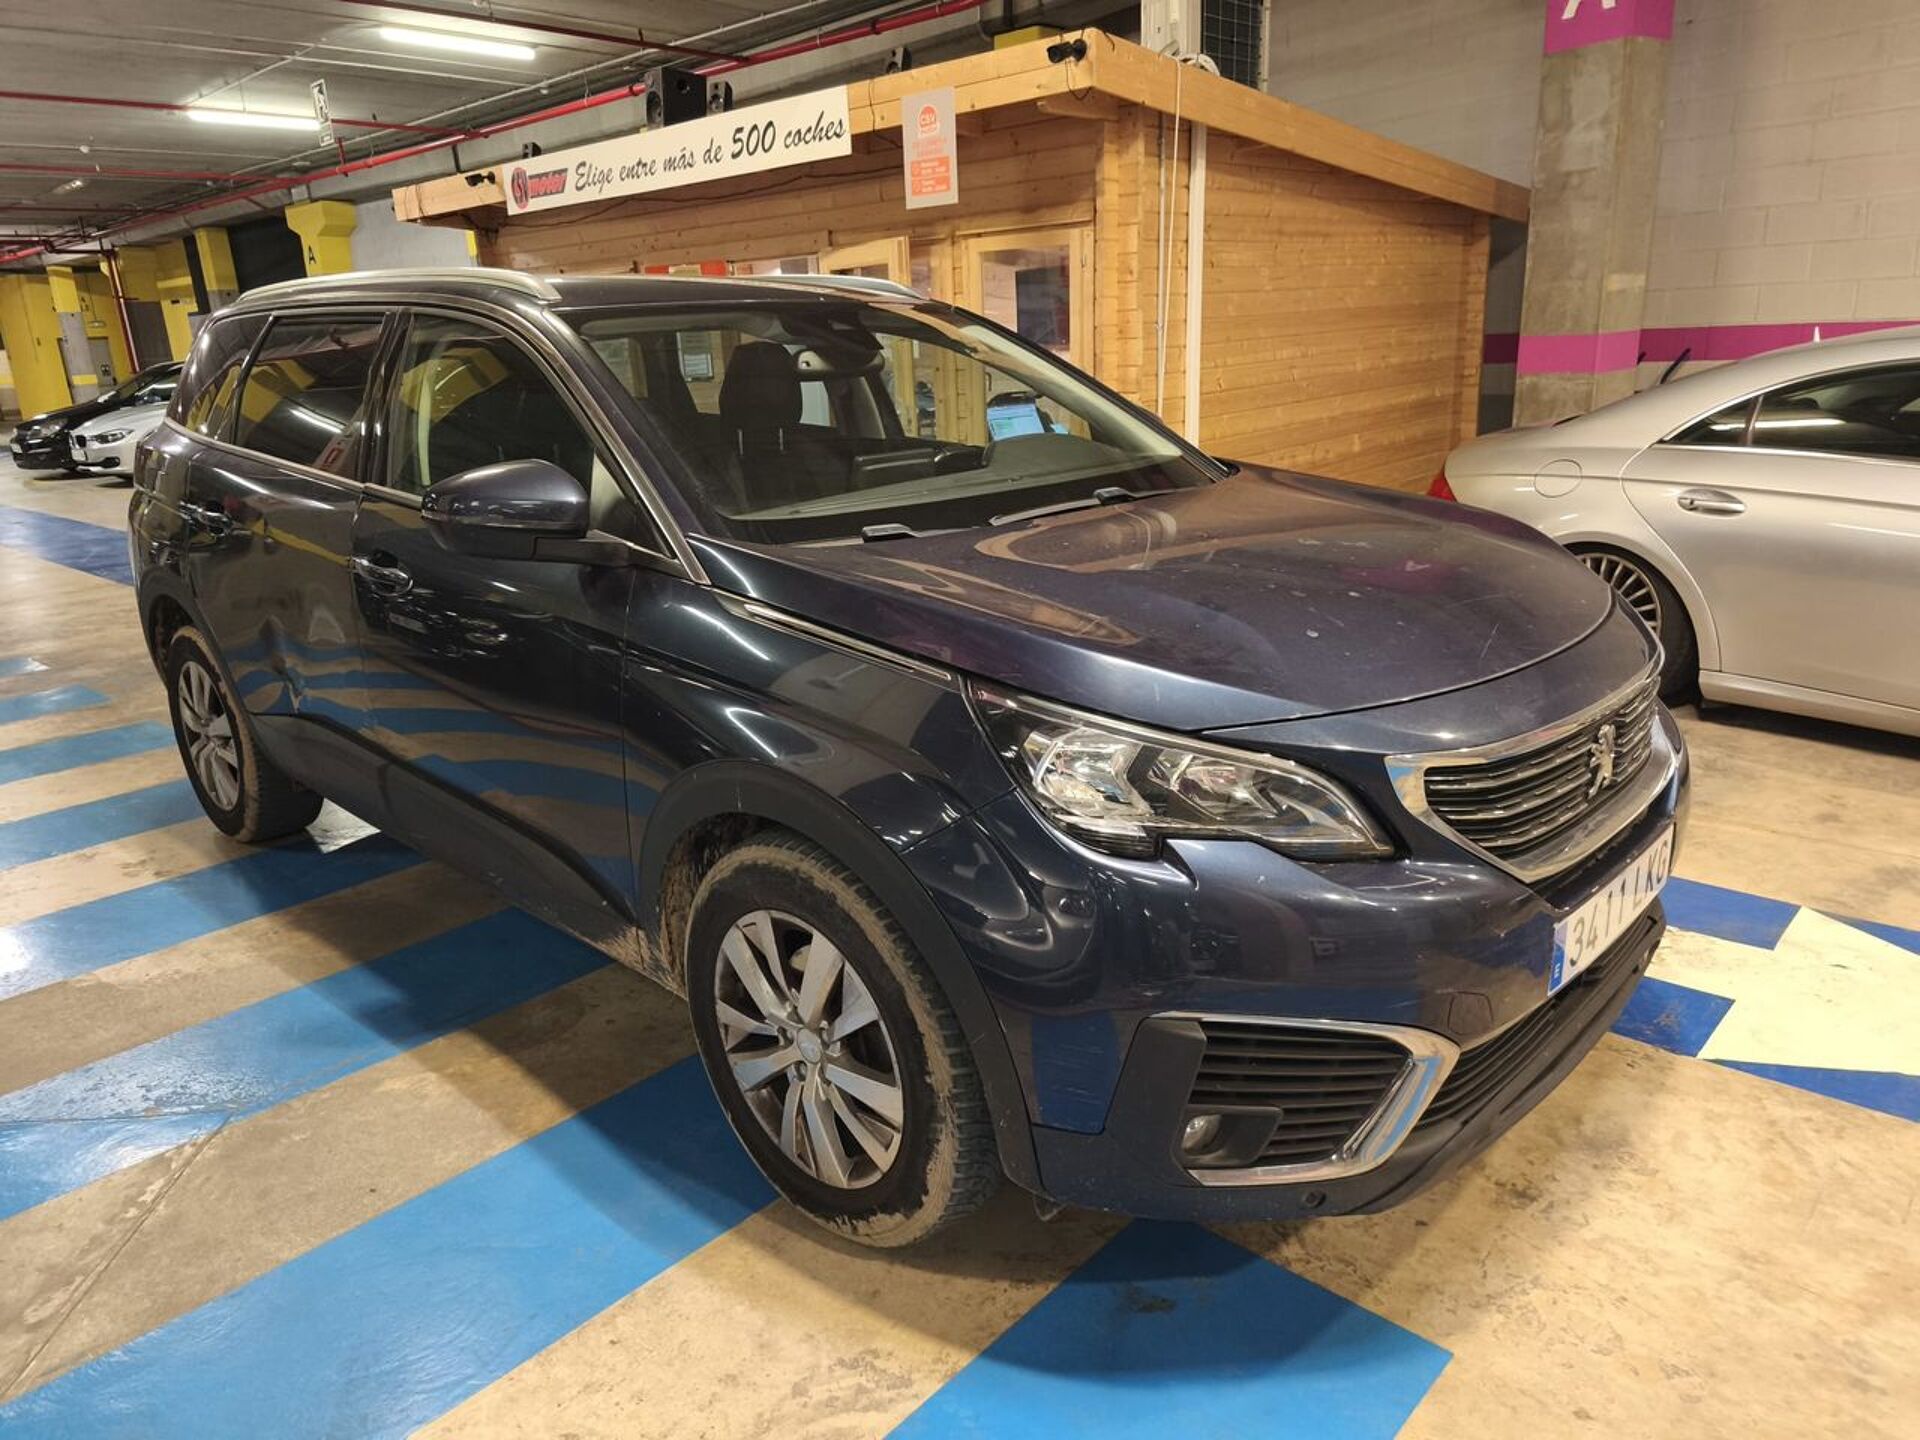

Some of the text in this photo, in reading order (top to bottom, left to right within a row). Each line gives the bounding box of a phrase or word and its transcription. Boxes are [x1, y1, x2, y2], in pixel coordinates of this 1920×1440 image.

[575, 110, 846, 193] Elige entre más de 500 coches
[308, 245, 317, 265] A
[1569, 840, 1668, 967] 3411 LKG
